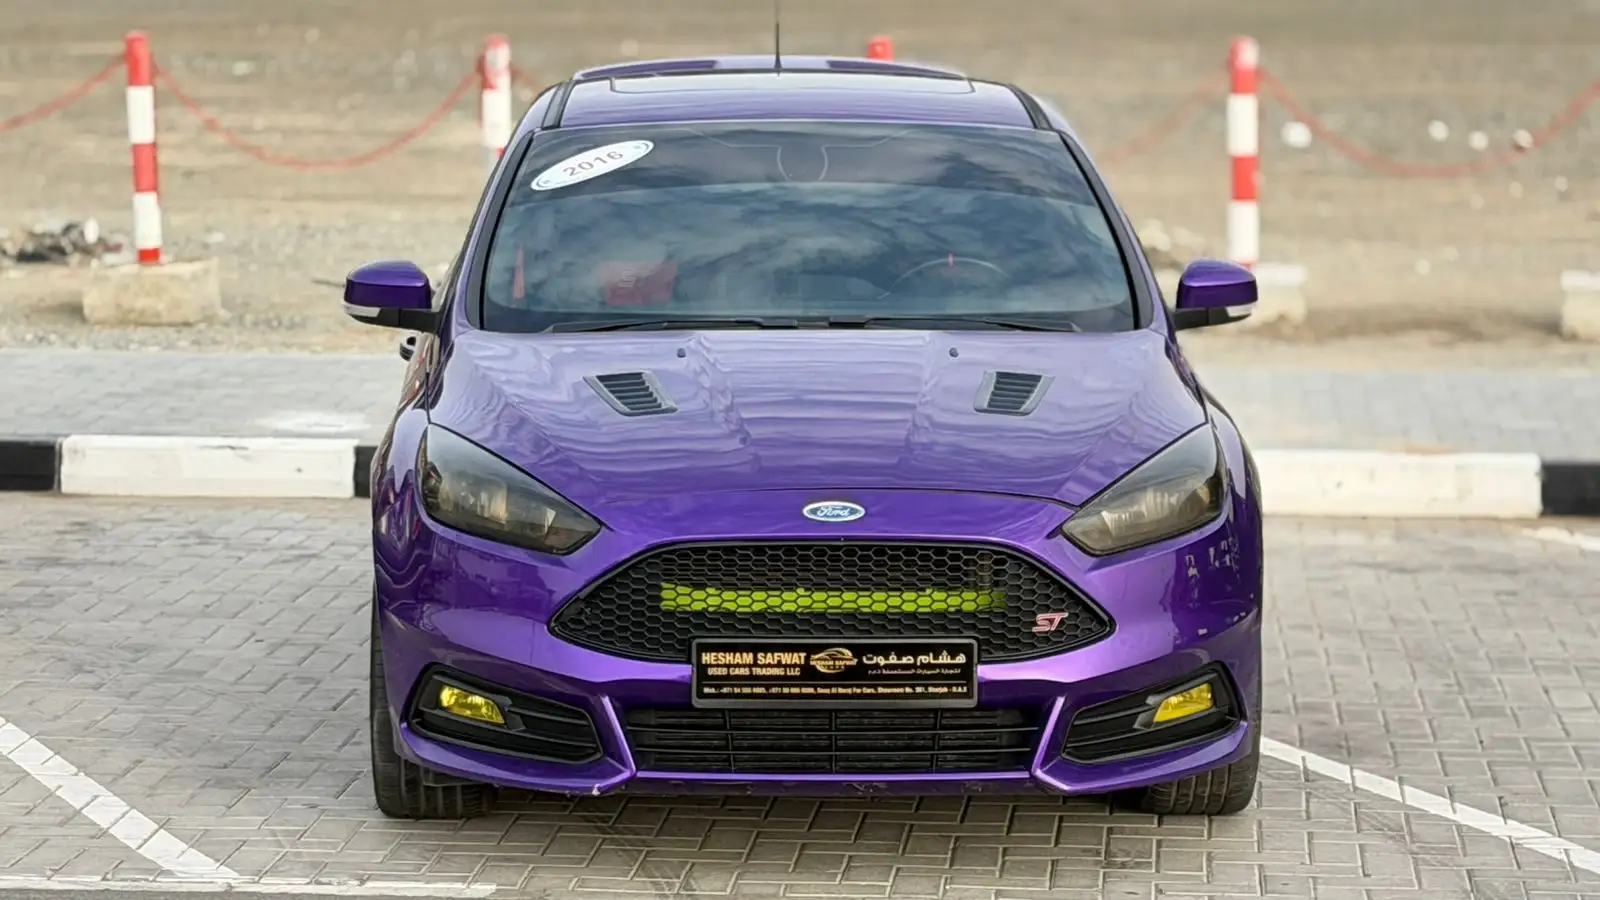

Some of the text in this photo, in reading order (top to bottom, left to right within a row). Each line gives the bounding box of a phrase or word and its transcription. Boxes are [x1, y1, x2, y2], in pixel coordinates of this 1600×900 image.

[563, 151, 623, 177] 2016
[817, 505, 851, 517] Ford
[1032, 612, 1069, 633] ST
[702, 652, 807, 665] HESHAM SAFWAT
[862, 650, 967, 666] هشام صفوت
[708, 667, 800, 675] USED CARS TRADING LLC
